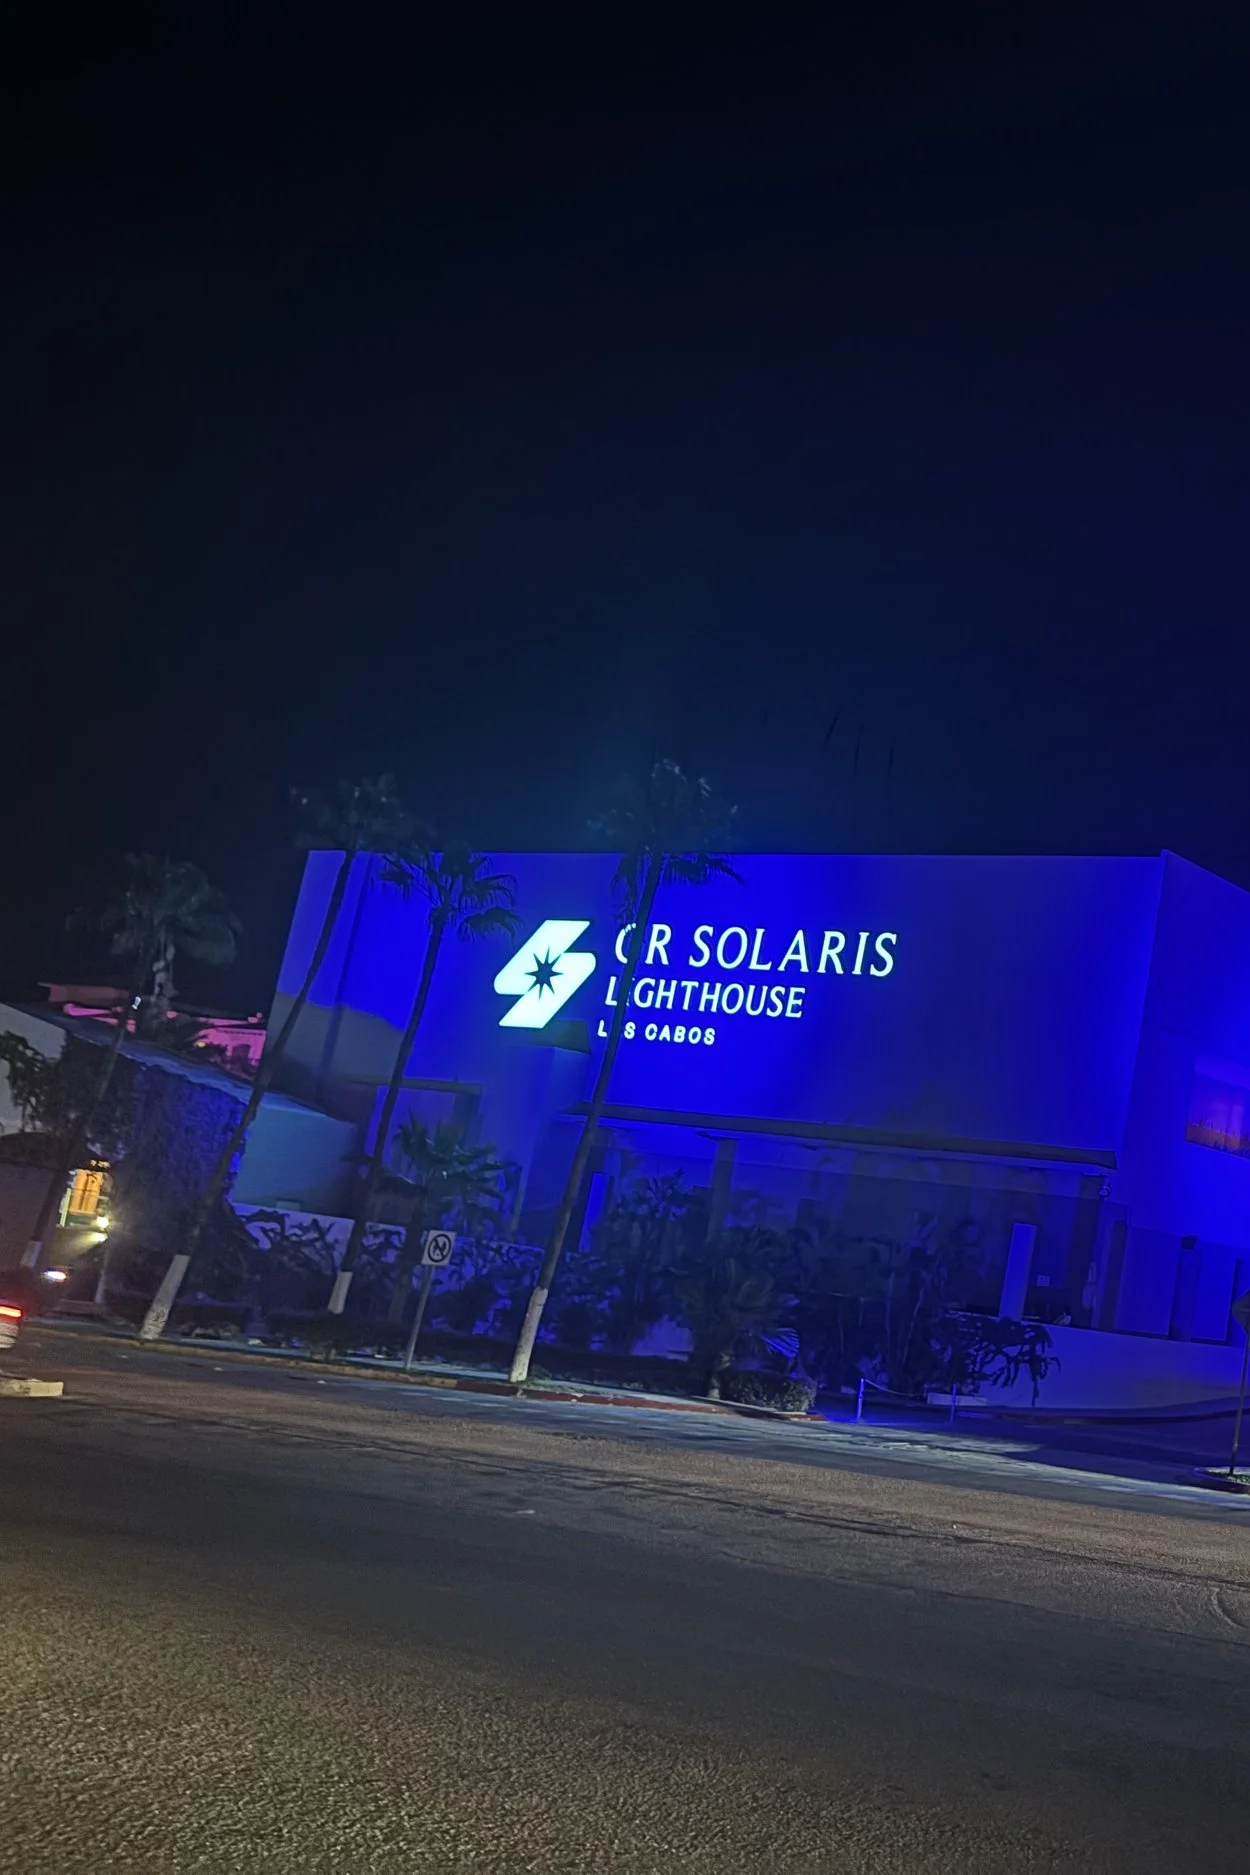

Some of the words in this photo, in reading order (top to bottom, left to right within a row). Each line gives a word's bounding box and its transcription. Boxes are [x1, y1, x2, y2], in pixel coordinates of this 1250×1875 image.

[688, 924, 897, 977] SOLARIS
[604, 975, 806, 1018] LGHTHOUSE
[597, 1019, 636, 1040] LS
[644, 1023, 716, 1045] CABOS
